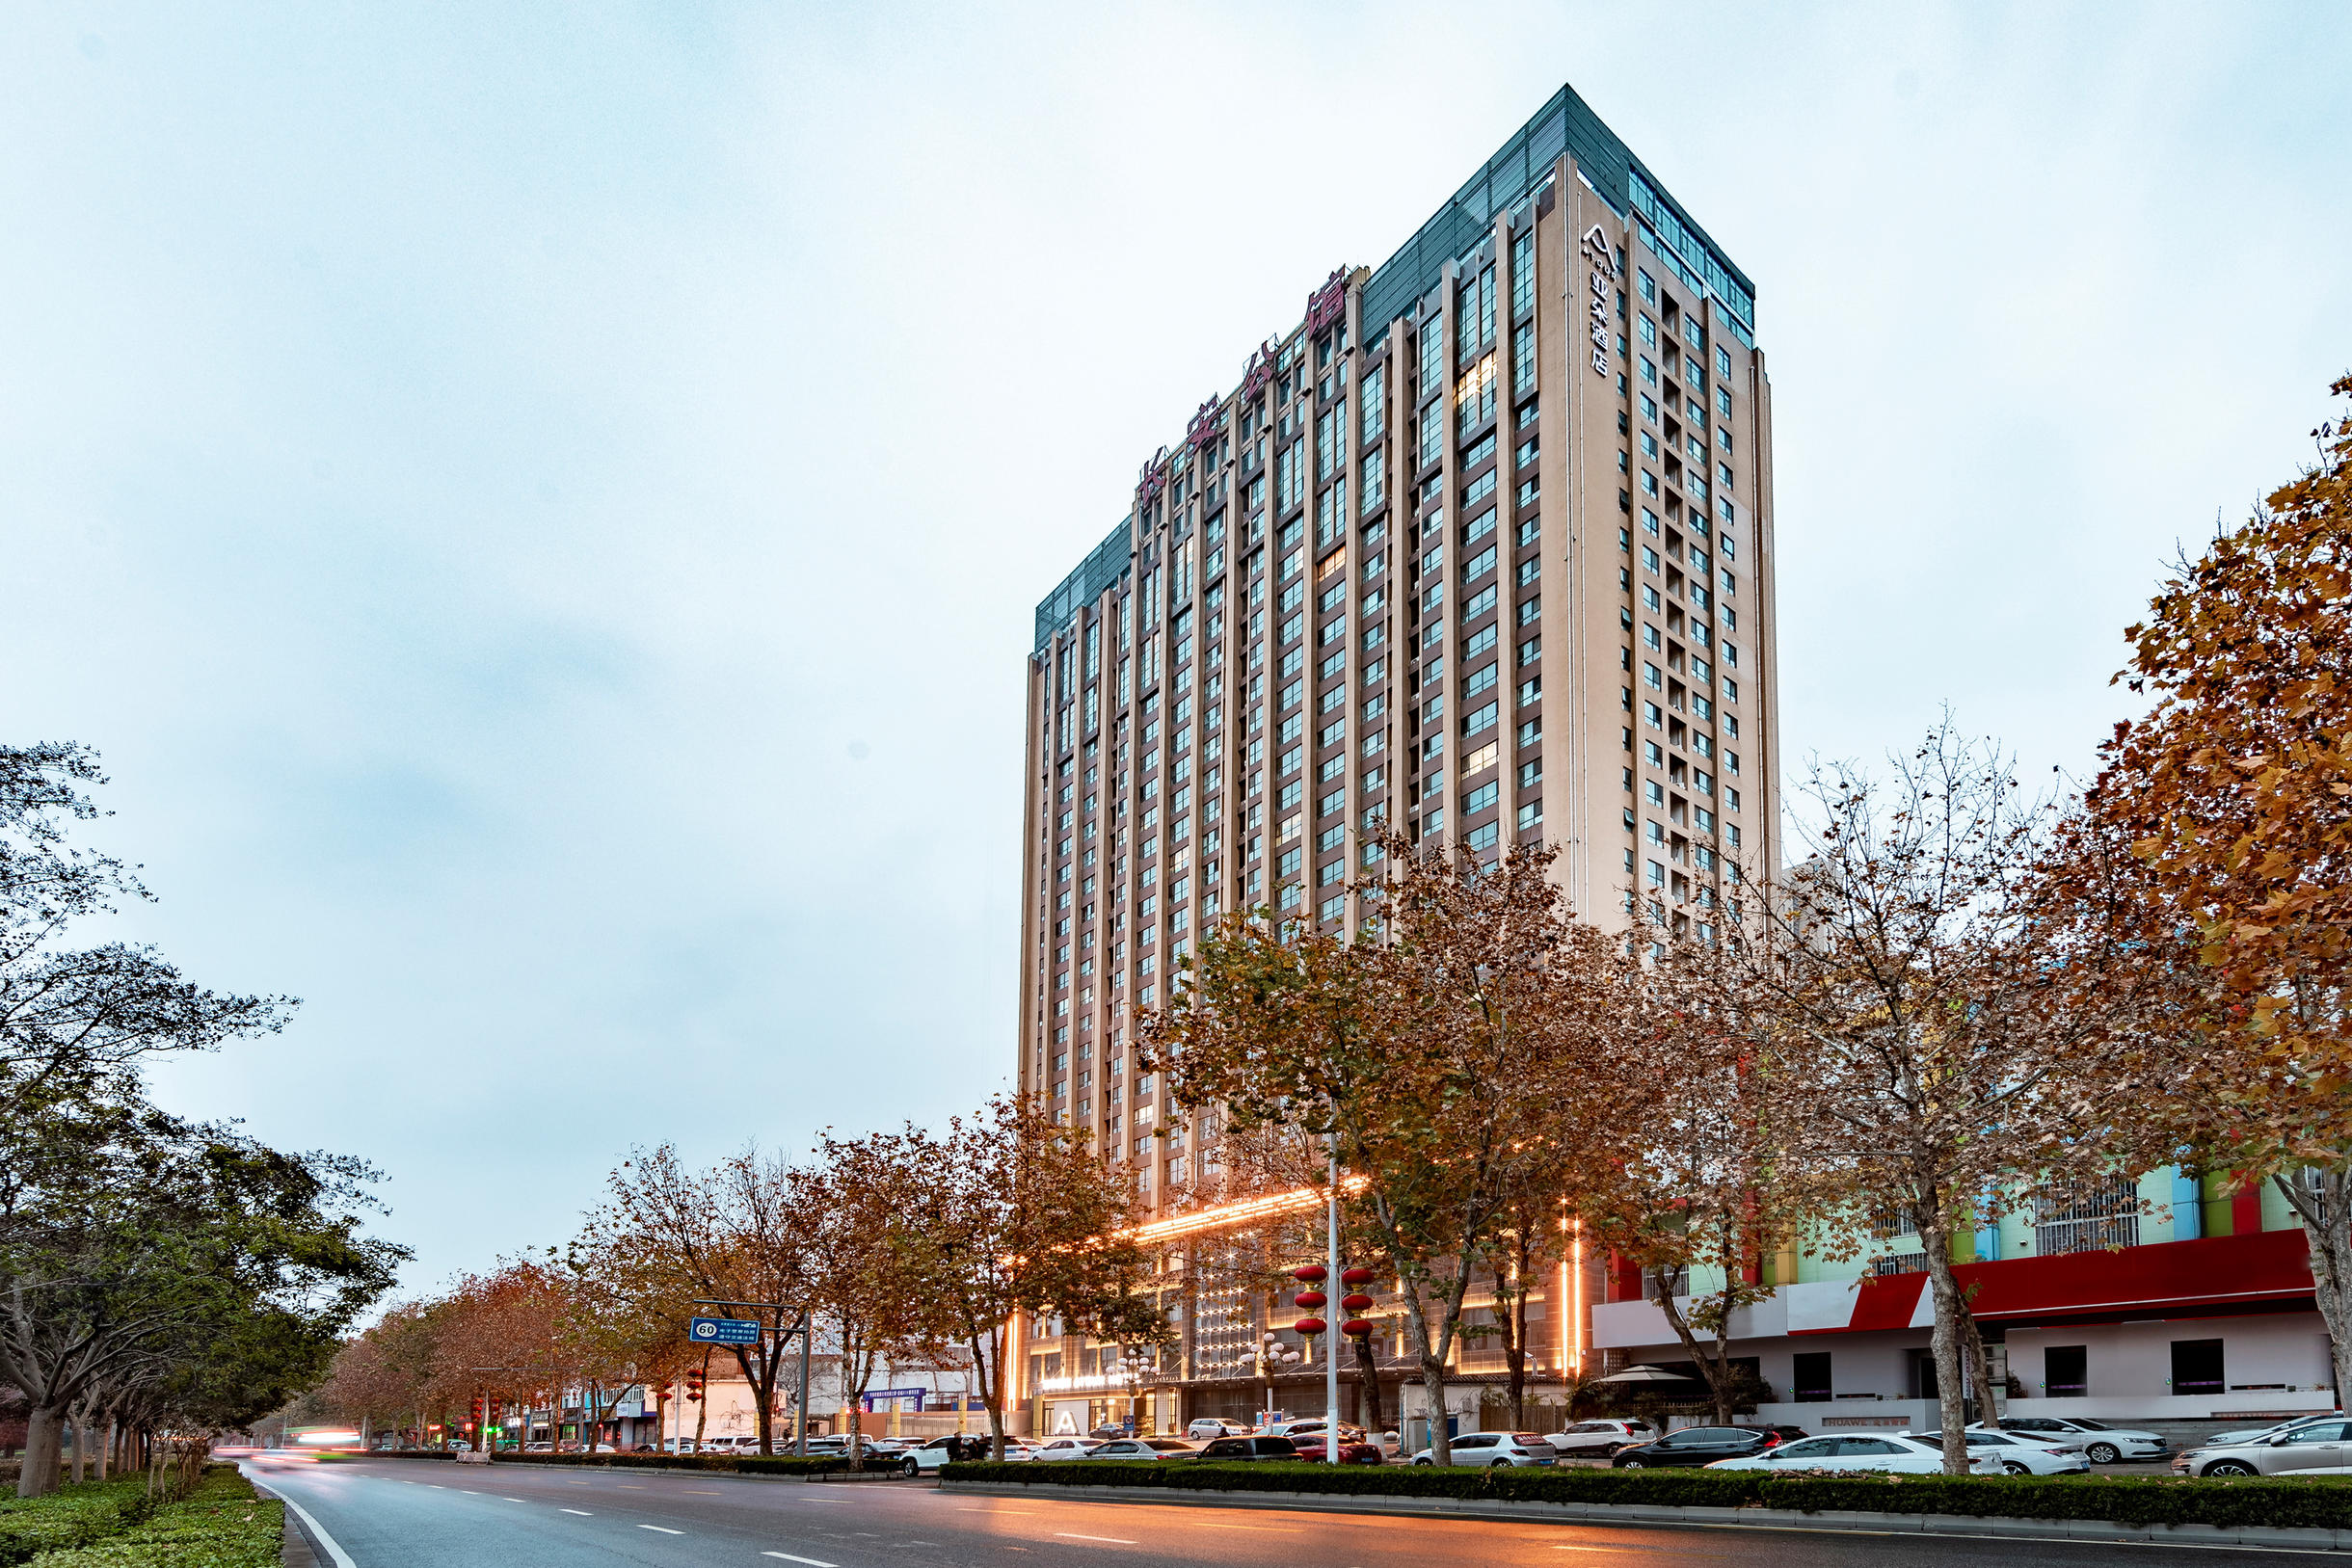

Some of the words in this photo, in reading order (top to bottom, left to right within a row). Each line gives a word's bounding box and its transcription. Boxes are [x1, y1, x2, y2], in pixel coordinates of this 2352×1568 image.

[1591, 271, 1609, 378] 亚朵酒店
[699, 1325, 714, 1334] 60
[1056, 1410, 1080, 1435] A
[1829, 1418, 1871, 1426] HUAWE
